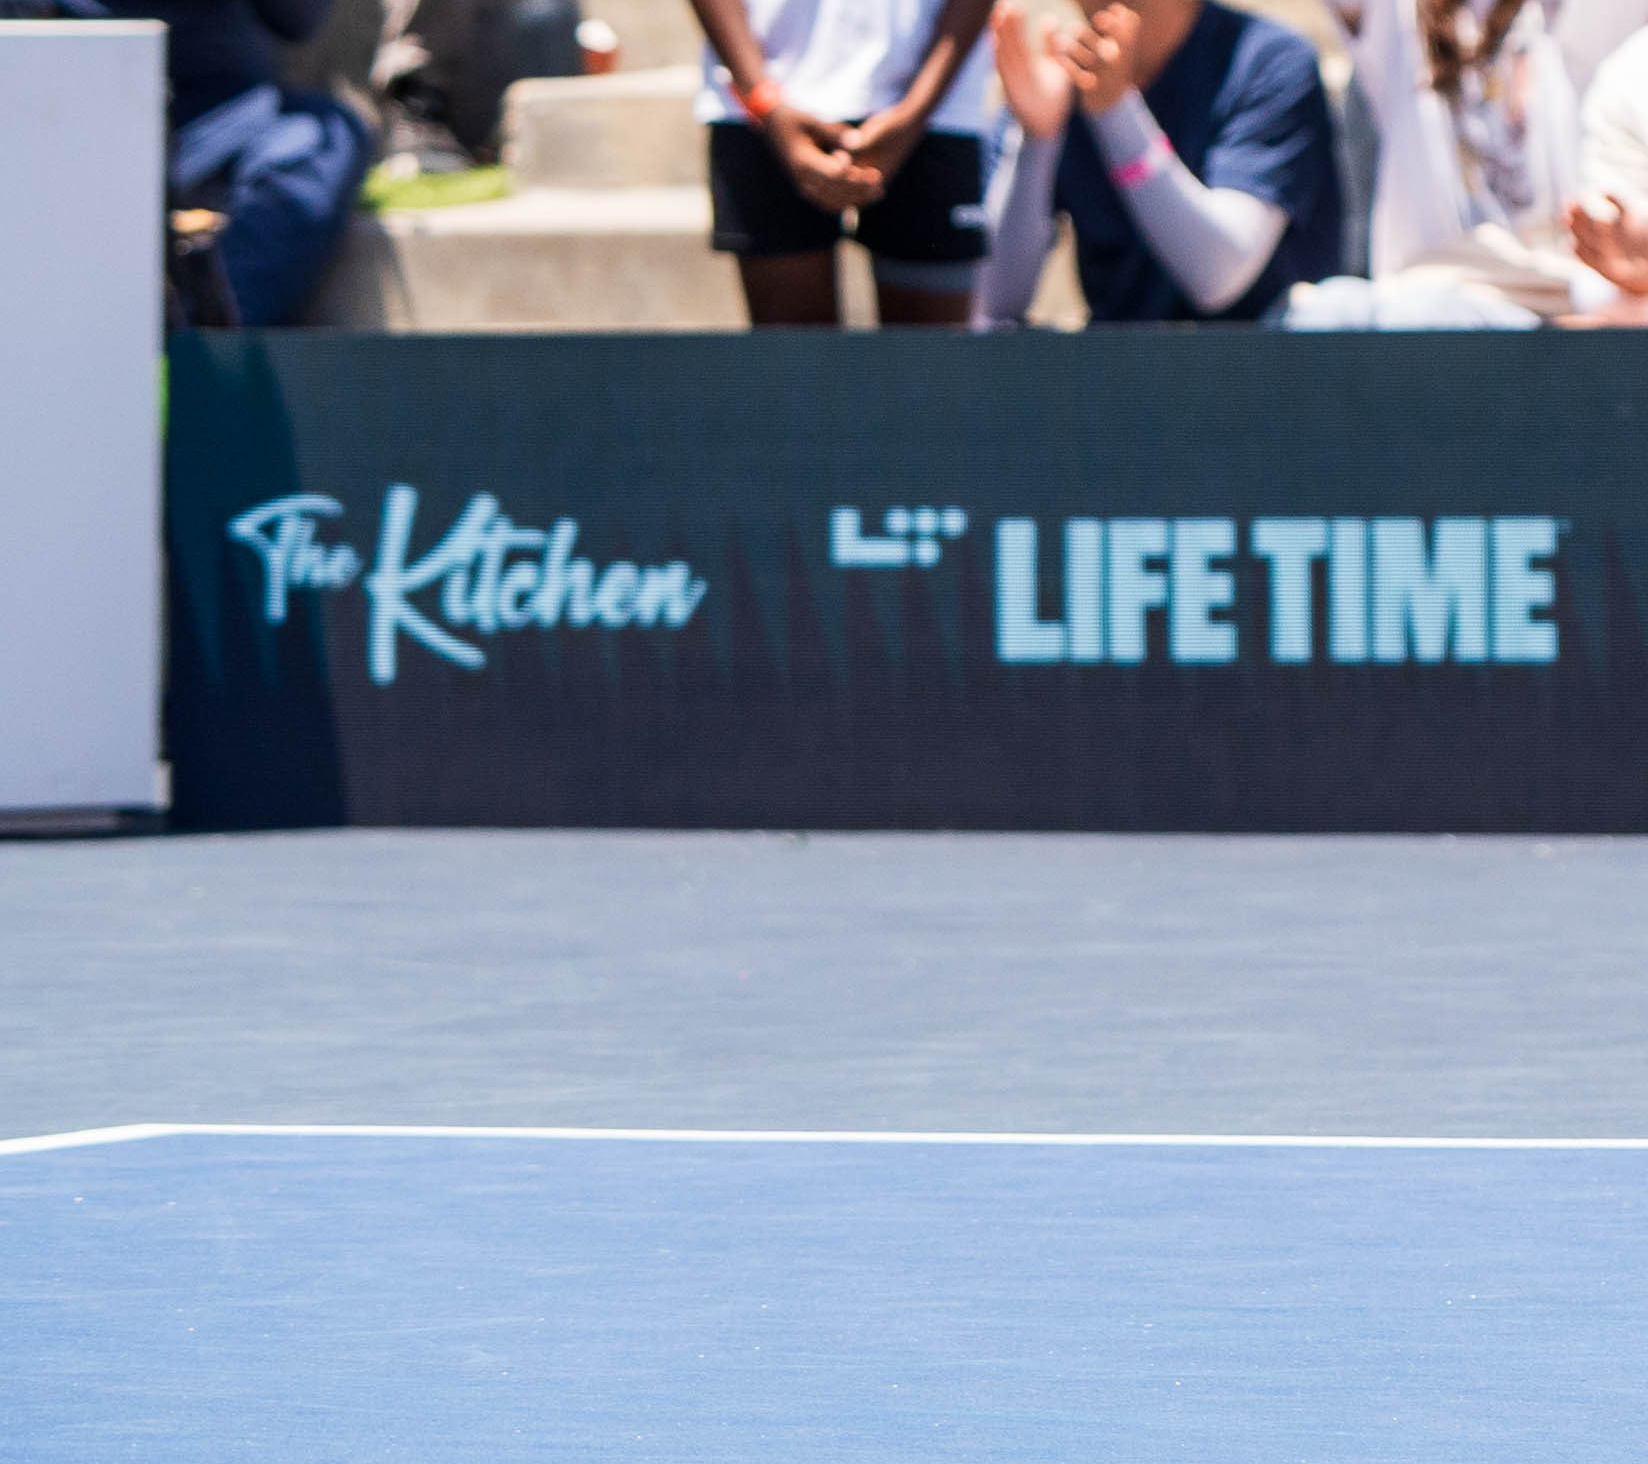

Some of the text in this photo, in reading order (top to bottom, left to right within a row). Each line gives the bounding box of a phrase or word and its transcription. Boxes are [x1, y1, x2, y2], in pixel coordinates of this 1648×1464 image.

[228, 482, 707, 686] The Kitchen
[996, 517, 1558, 663] LIFE TIME
